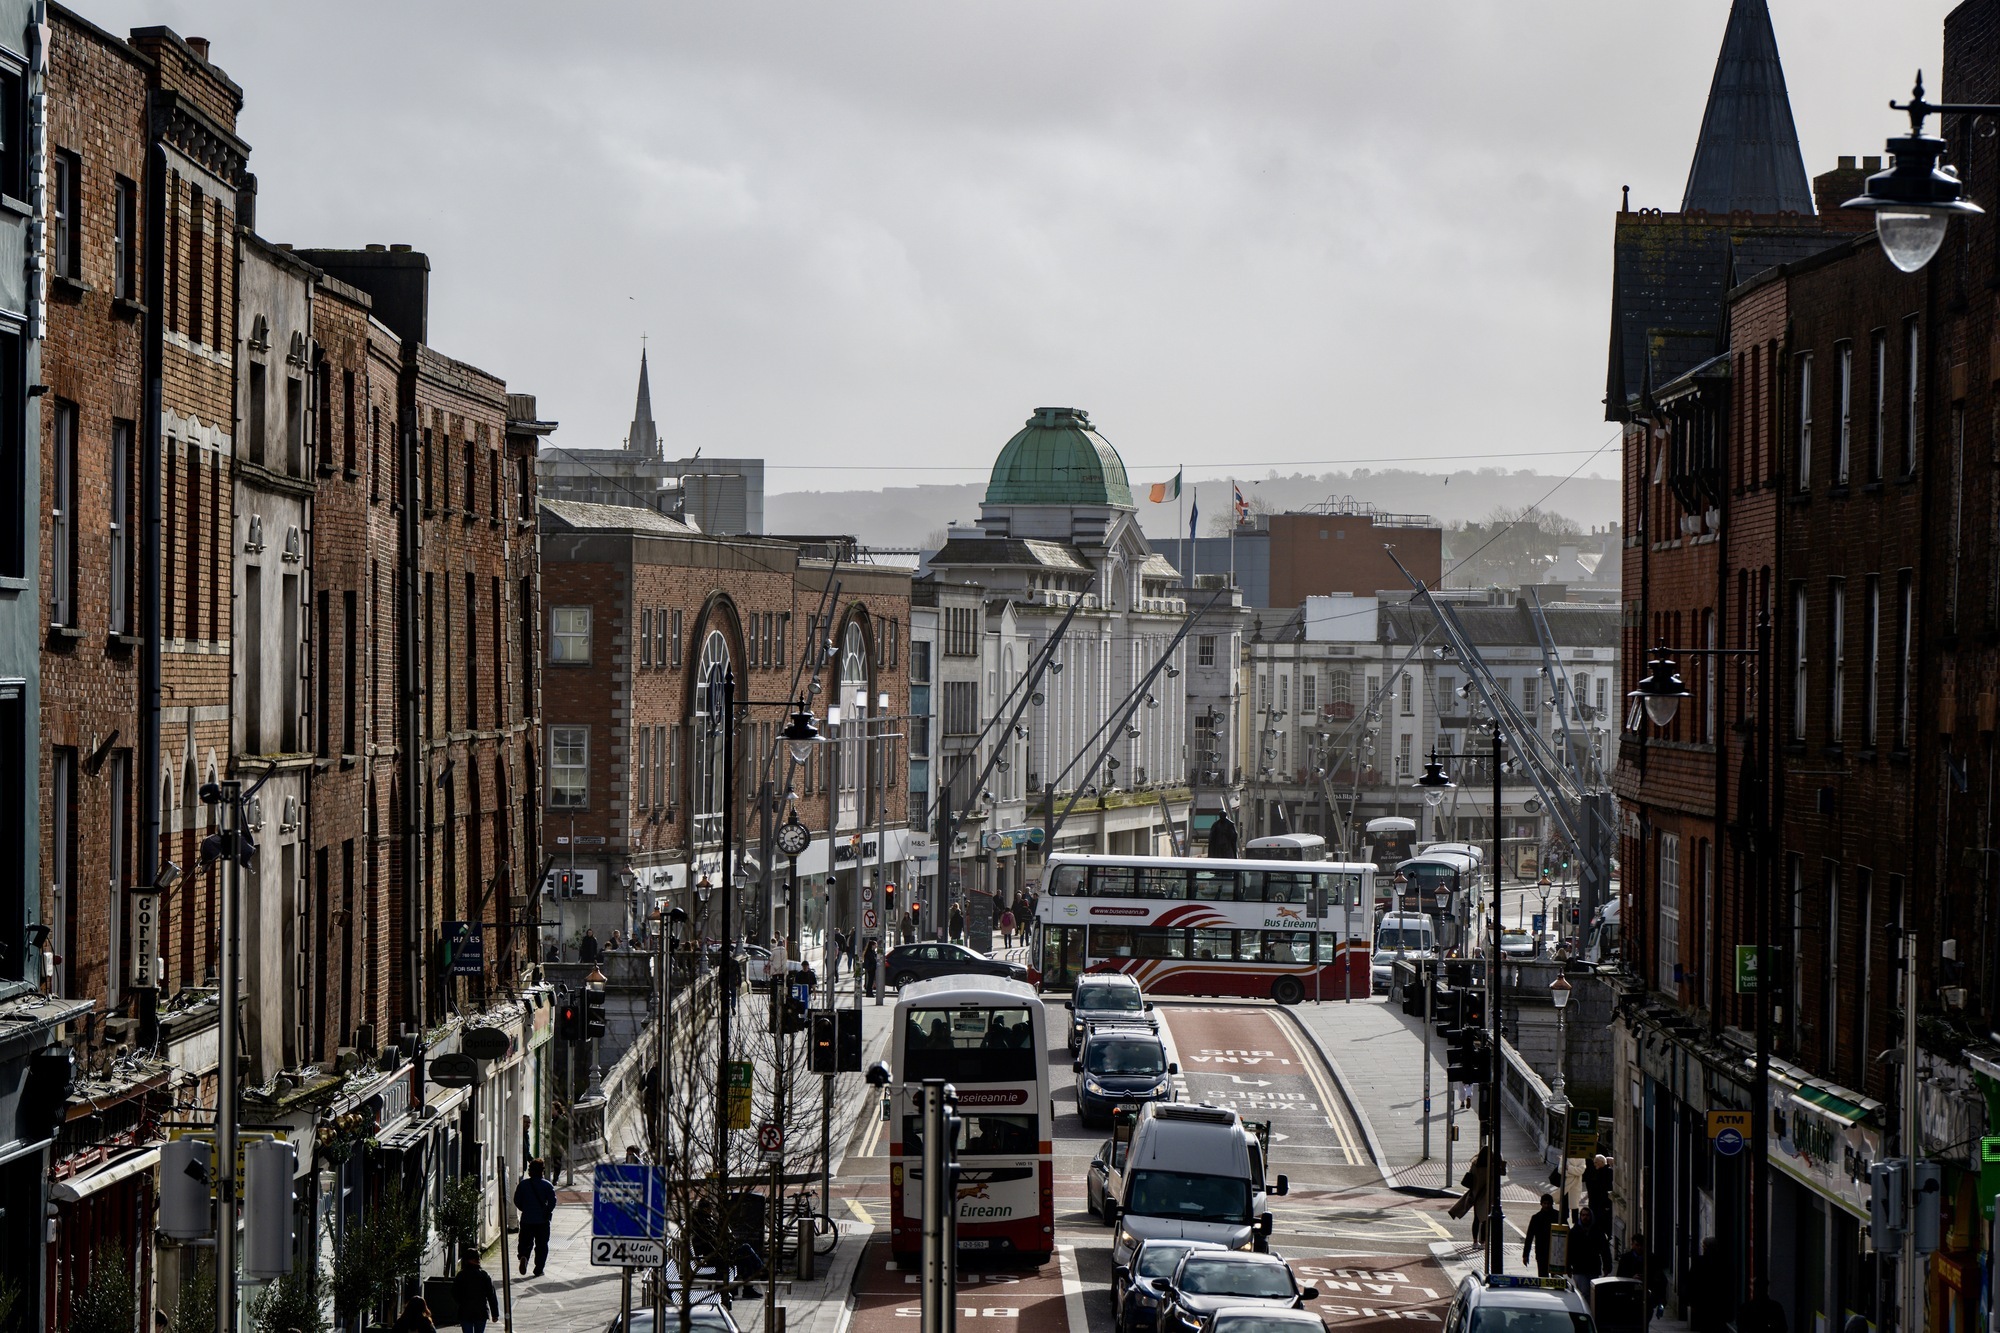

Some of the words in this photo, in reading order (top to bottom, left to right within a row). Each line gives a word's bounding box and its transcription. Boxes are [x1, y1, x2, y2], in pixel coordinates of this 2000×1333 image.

[1264, 918, 1281, 927] Bus
[1283, 917, 1317, 929] Éireann
[138, 897, 151, 981] COFFEE
[1200, 1049, 1274, 1057] BUS
[1207, 1090, 1306, 1101] BUSES
[1716, 1115, 1744, 1124] ATM
[960, 1202, 1013, 1217] Éireann
[597, 1241, 628, 1263] 24
[630, 1253, 659, 1264] HOUR
[1298, 1266, 1411, 1282] BUS
[1516, 1277, 1541, 1286] TAXI
[1545, 1279, 1565, 1287] 55949
[1319, 1304, 1443, 1322] BUS
